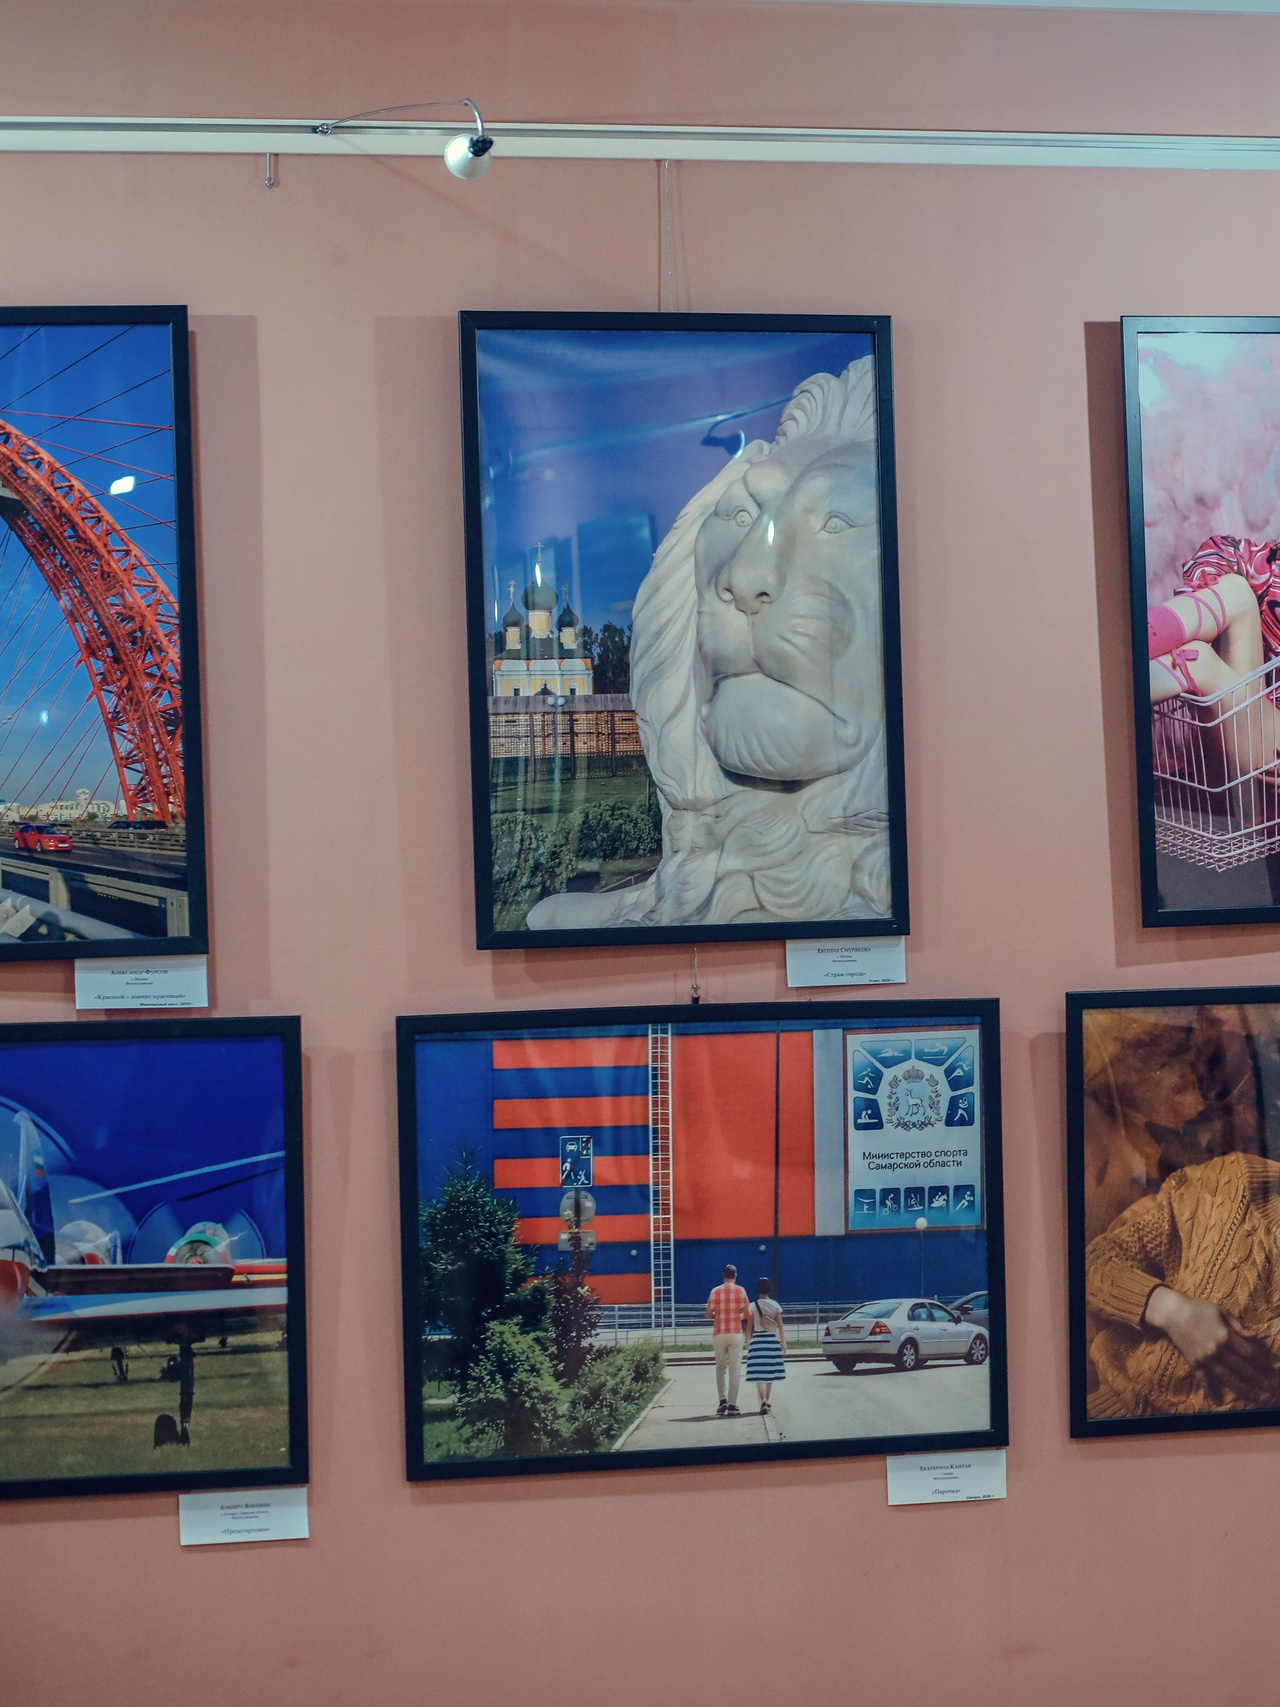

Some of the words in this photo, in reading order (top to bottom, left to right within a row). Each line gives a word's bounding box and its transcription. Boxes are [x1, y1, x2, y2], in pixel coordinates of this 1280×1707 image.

[862, 1150, 932, 1161] Министерство
[934, 1149, 968, 1159] спорта
[868, 1160, 921, 1171] Самарской
[923, 1159, 962, 1168] области
